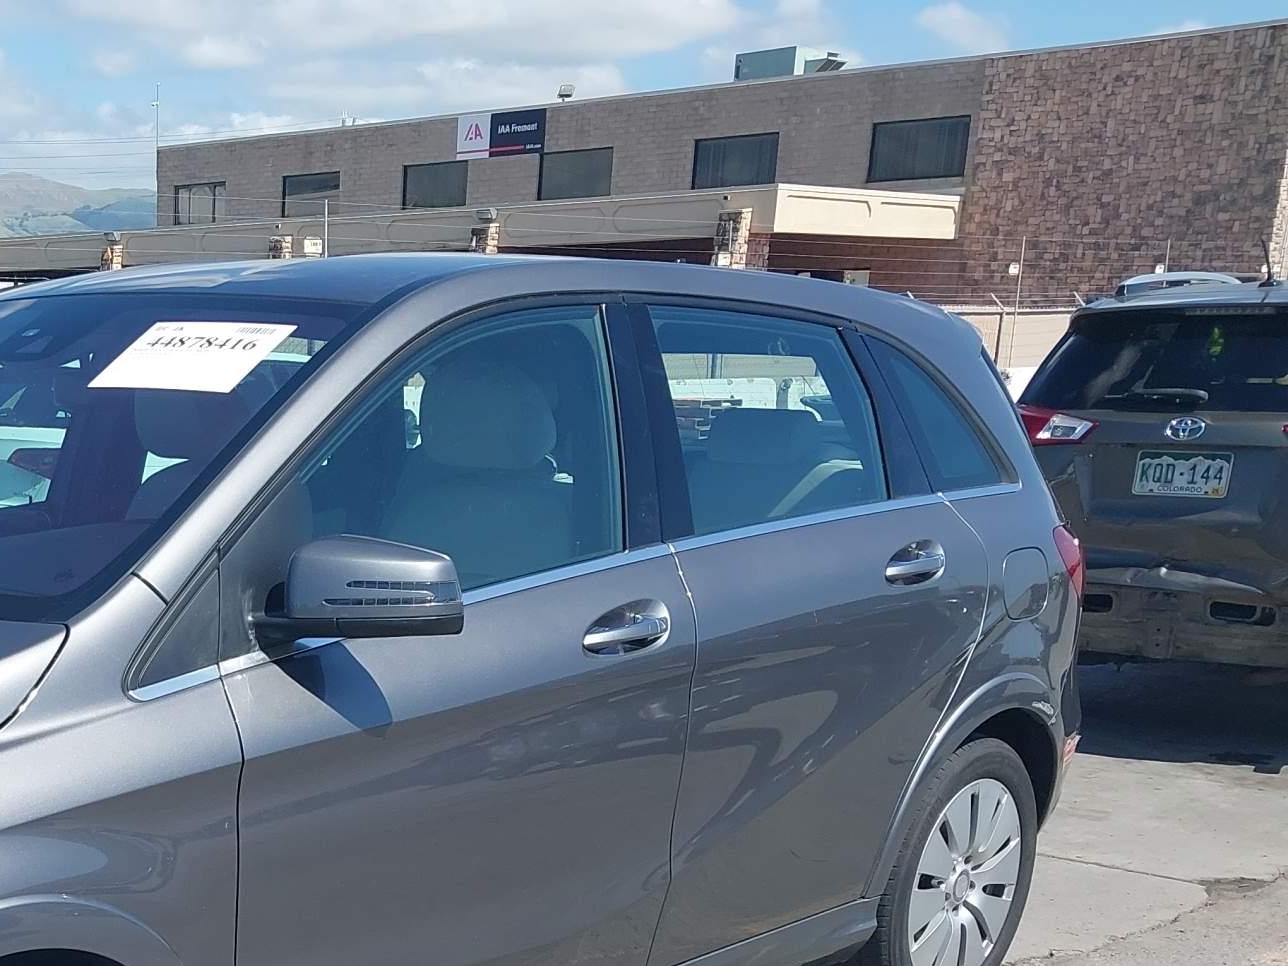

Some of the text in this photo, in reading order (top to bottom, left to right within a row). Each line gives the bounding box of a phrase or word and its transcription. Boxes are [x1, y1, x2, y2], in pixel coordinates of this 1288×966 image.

[497, 121, 538, 134] IAA Fremont
[146, 336, 258, 351] 44878416
[1157, 485, 1203, 494] COLORADO
